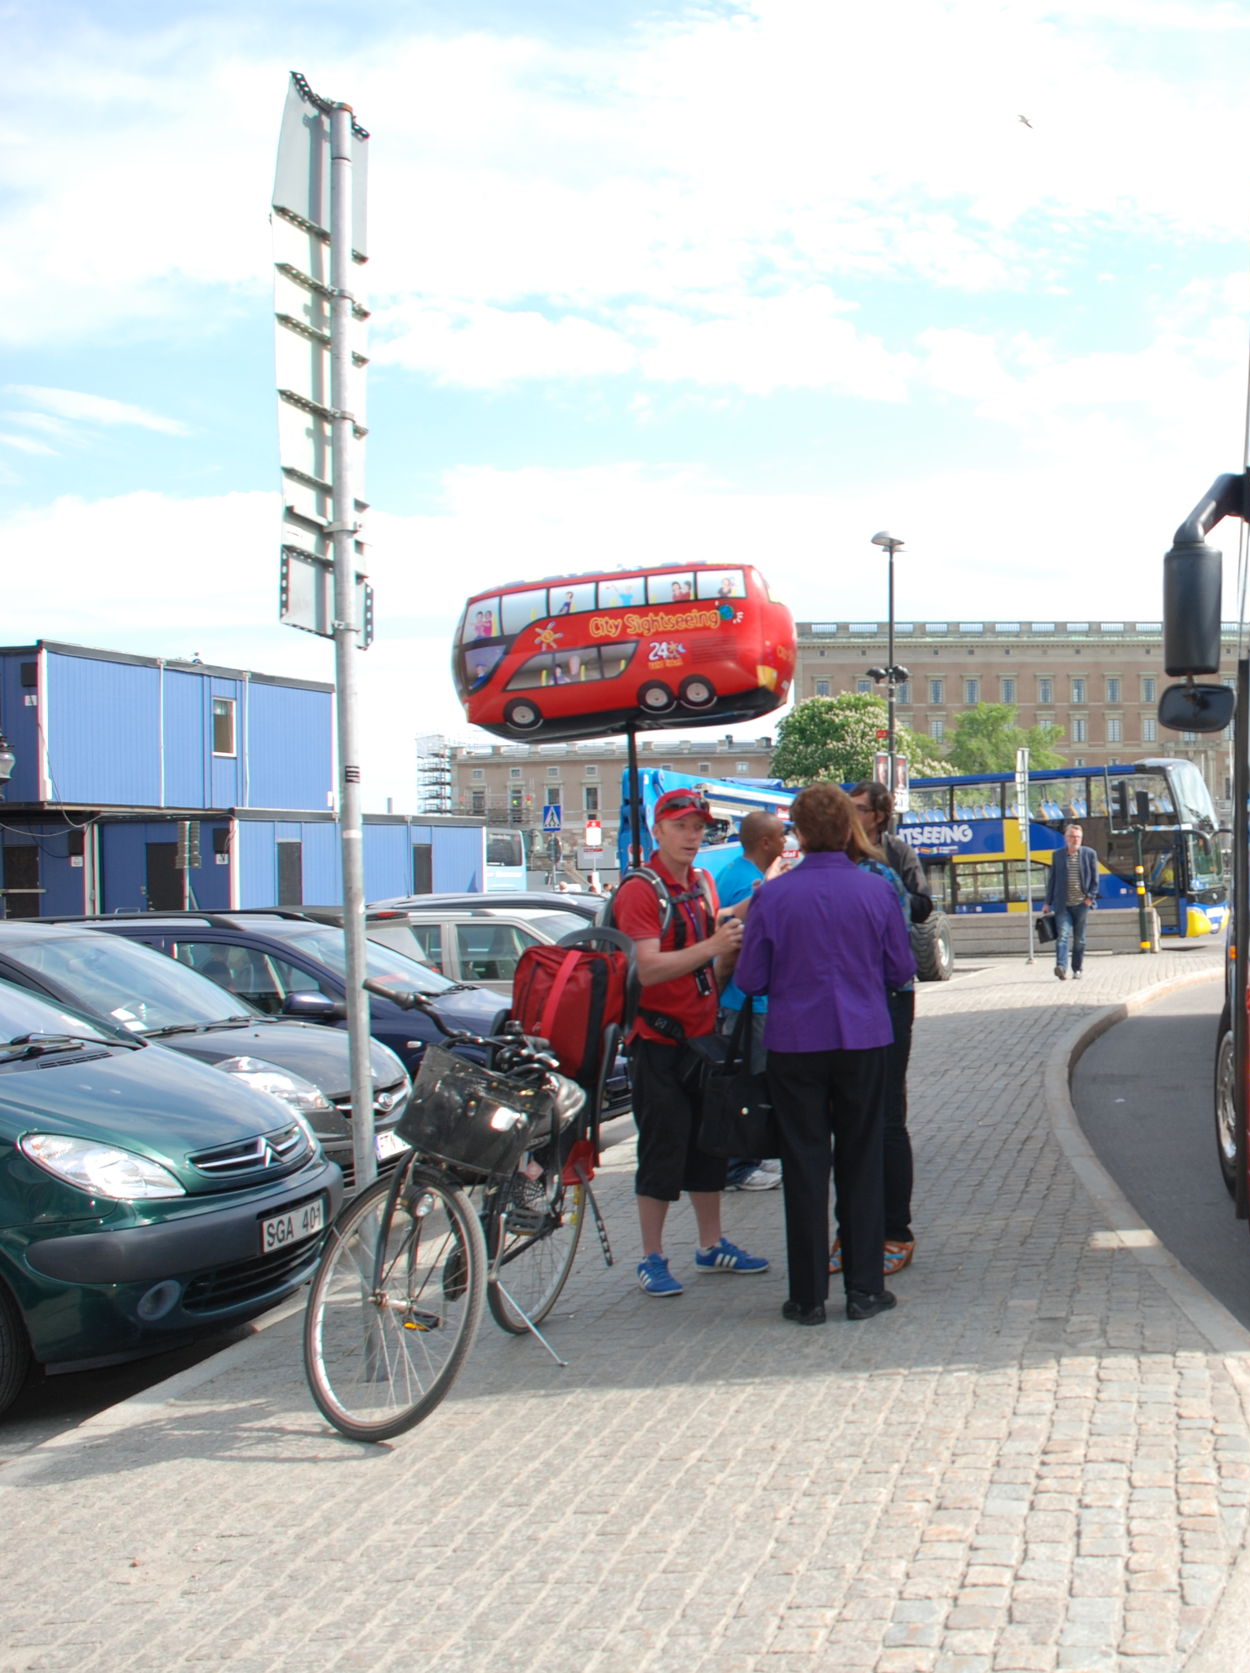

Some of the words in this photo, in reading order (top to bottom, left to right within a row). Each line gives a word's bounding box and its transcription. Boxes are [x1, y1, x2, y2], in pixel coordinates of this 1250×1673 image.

[589, 616, 622, 638] City
[624, 609, 721, 636] Sightseeing
[266, 1216, 294, 1248] SGA
[301, 1204, 321, 1233] 401
